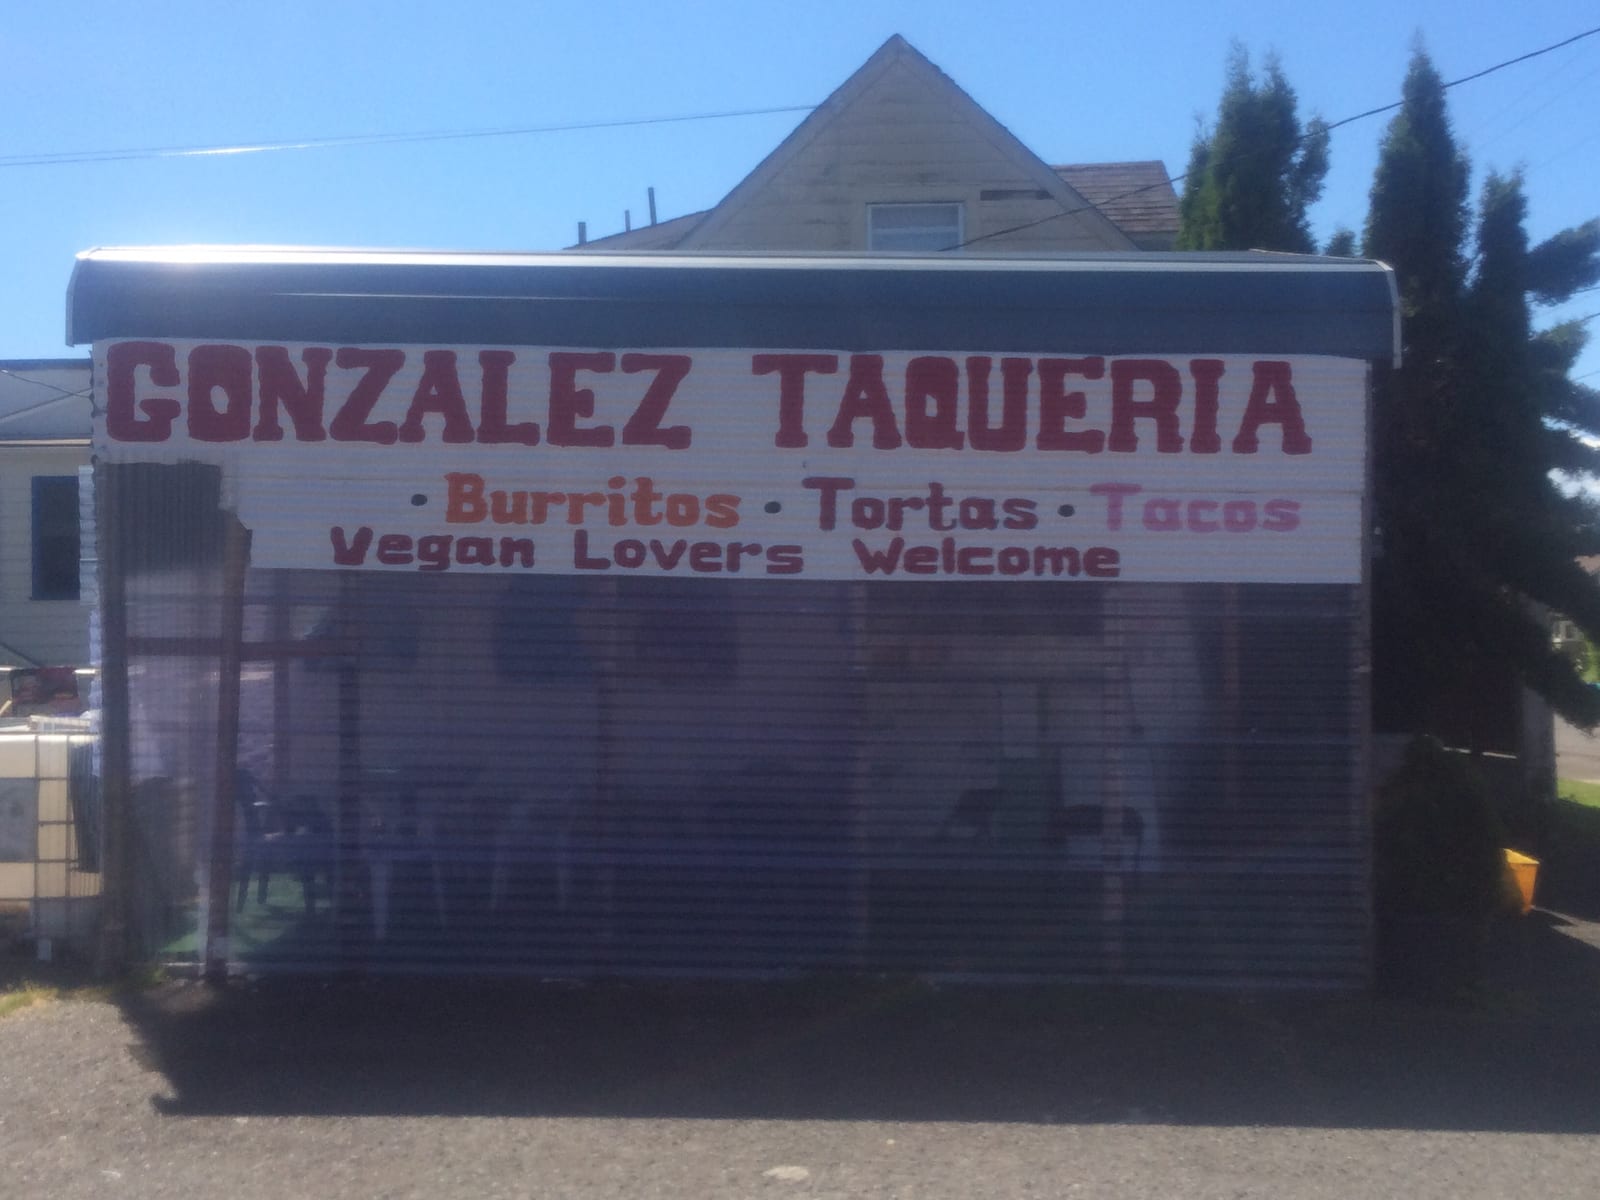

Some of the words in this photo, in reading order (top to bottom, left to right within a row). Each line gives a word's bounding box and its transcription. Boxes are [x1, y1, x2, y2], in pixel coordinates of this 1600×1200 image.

[106, 341, 693, 450] GONZALEZ
[752, 353, 1312, 455] TAQUERIA
[444, 473, 742, 529] Burritos
[802, 476, 1039, 531] Tortas
[1090, 482, 1303, 533] Tacos
[329, 525, 536, 571] Vegan
[573, 528, 804, 575] Lovers
[851, 537, 1121, 578] Welcome
